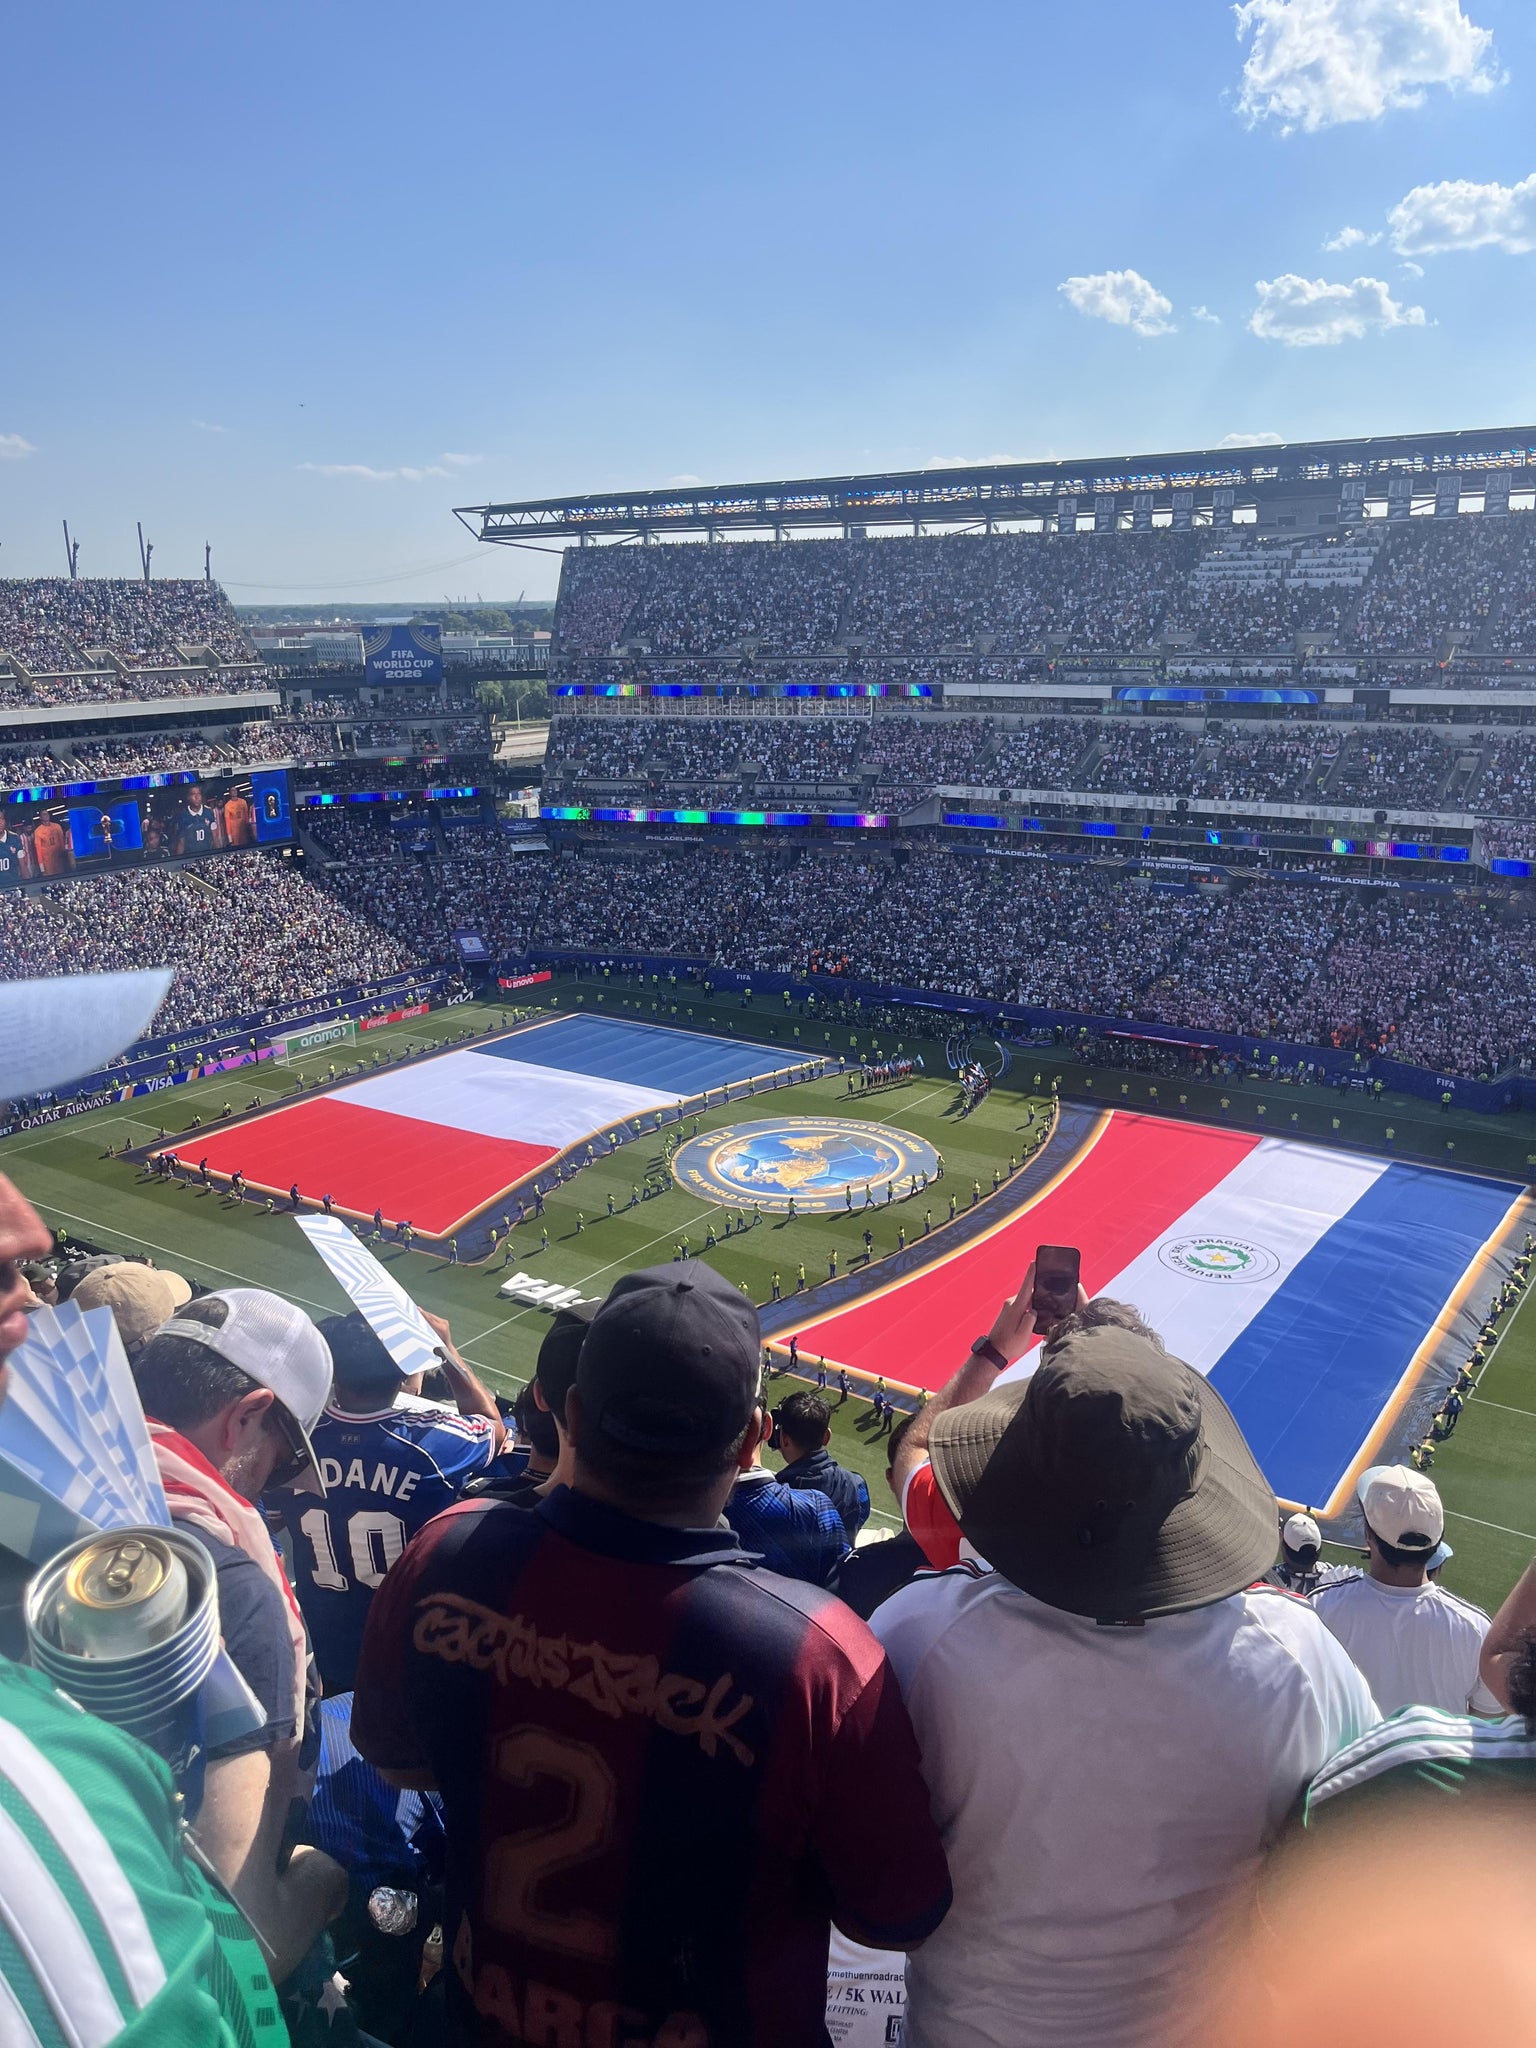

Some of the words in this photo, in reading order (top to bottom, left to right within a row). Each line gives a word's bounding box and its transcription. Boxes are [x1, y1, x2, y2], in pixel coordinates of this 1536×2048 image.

[392, 650, 414, 659] FIFA
[373, 660, 412, 669] WORLD
[413, 660, 434, 668] CUP
[385, 670, 422, 679] 2026
[196, 829, 205, 842] 10
[986, 848, 1048, 859] PHILADELPHIA
[1155, 862, 1175, 870] WORLD
[1320, 875, 1400, 888] PHILADELPHIA
[401, 1005, 422, 1019] Coca-Cola
[367, 1014, 389, 1029] Coca-Cola
[300, 1026, 347, 1047] aramco
[145, 1076, 175, 1092] VISA
[1436, 1077, 1455, 1089] FIFA
[21, 1109, 60, 1130] QATAR
[65, 1094, 112, 1117] AIRWAYS
[696, 1131, 734, 1147] FIFA
[700, 1182, 738, 1200] WORLD
[738, 1197, 767, 1205] CUP
[1190, 1238, 1258, 1252] PARAGUAY
[501, 1271, 602, 1311] IFA
[294, 1457, 421, 1501] DANE
[301, 1508, 407, 1591] 10
[484, 1722, 620, 1961] 2
[845, 1987, 865, 2002] 5K
[870, 1989, 905, 2004] WAL
